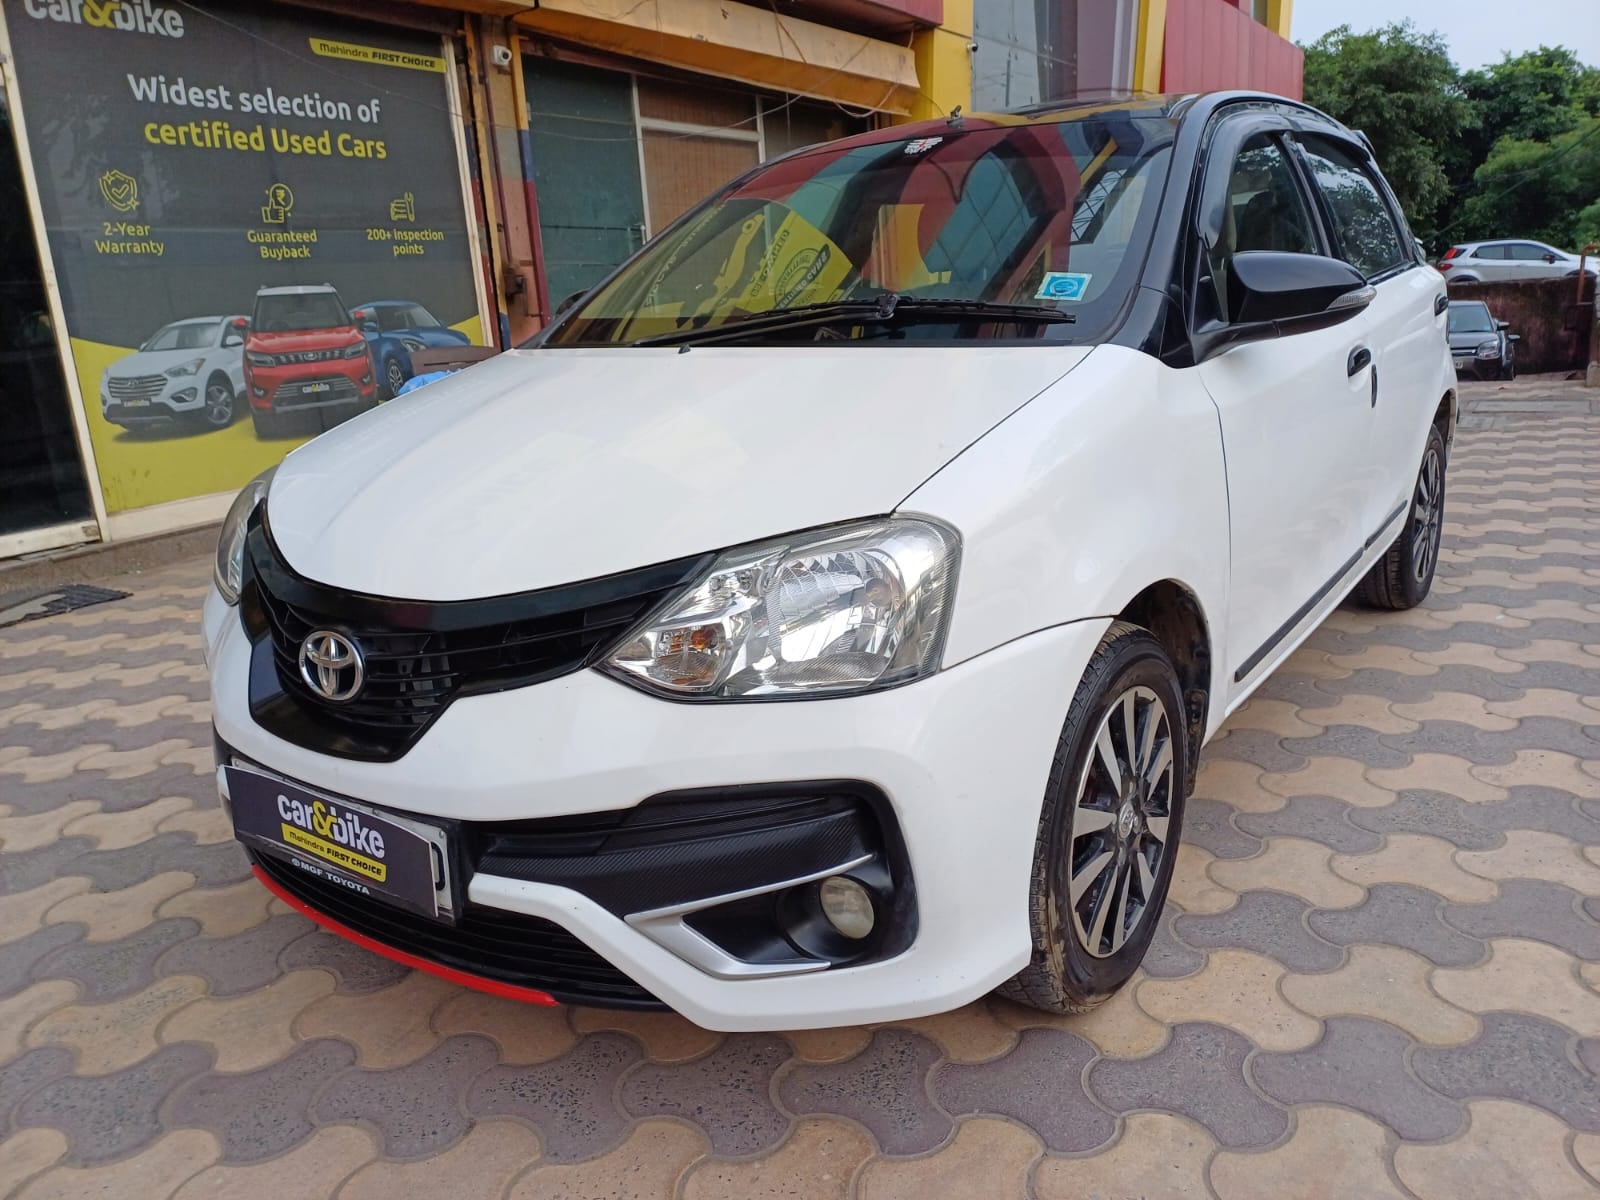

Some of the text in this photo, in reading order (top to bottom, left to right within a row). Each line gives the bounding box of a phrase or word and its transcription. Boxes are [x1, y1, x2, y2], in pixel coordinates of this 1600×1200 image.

[319, 42, 436, 68] Mahindra FIRST CHOICE
[127, 73, 381, 123] Widest selection of
[144, 120, 388, 160] certified Used Cars
[103, 222, 151, 237] 2-Year
[247, 229, 318, 243] Guaranteed
[366, 228, 445, 243] 200+ inspection
[95, 239, 164, 256] Warranty
[260, 245, 311, 260] Buyback
[392, 243, 425, 257] points
[277, 794, 385, 859] car&bike
[289, 831, 382, 876] Mahindra FIRST CHOICE
[325, 872, 370, 895] TOYOTA
